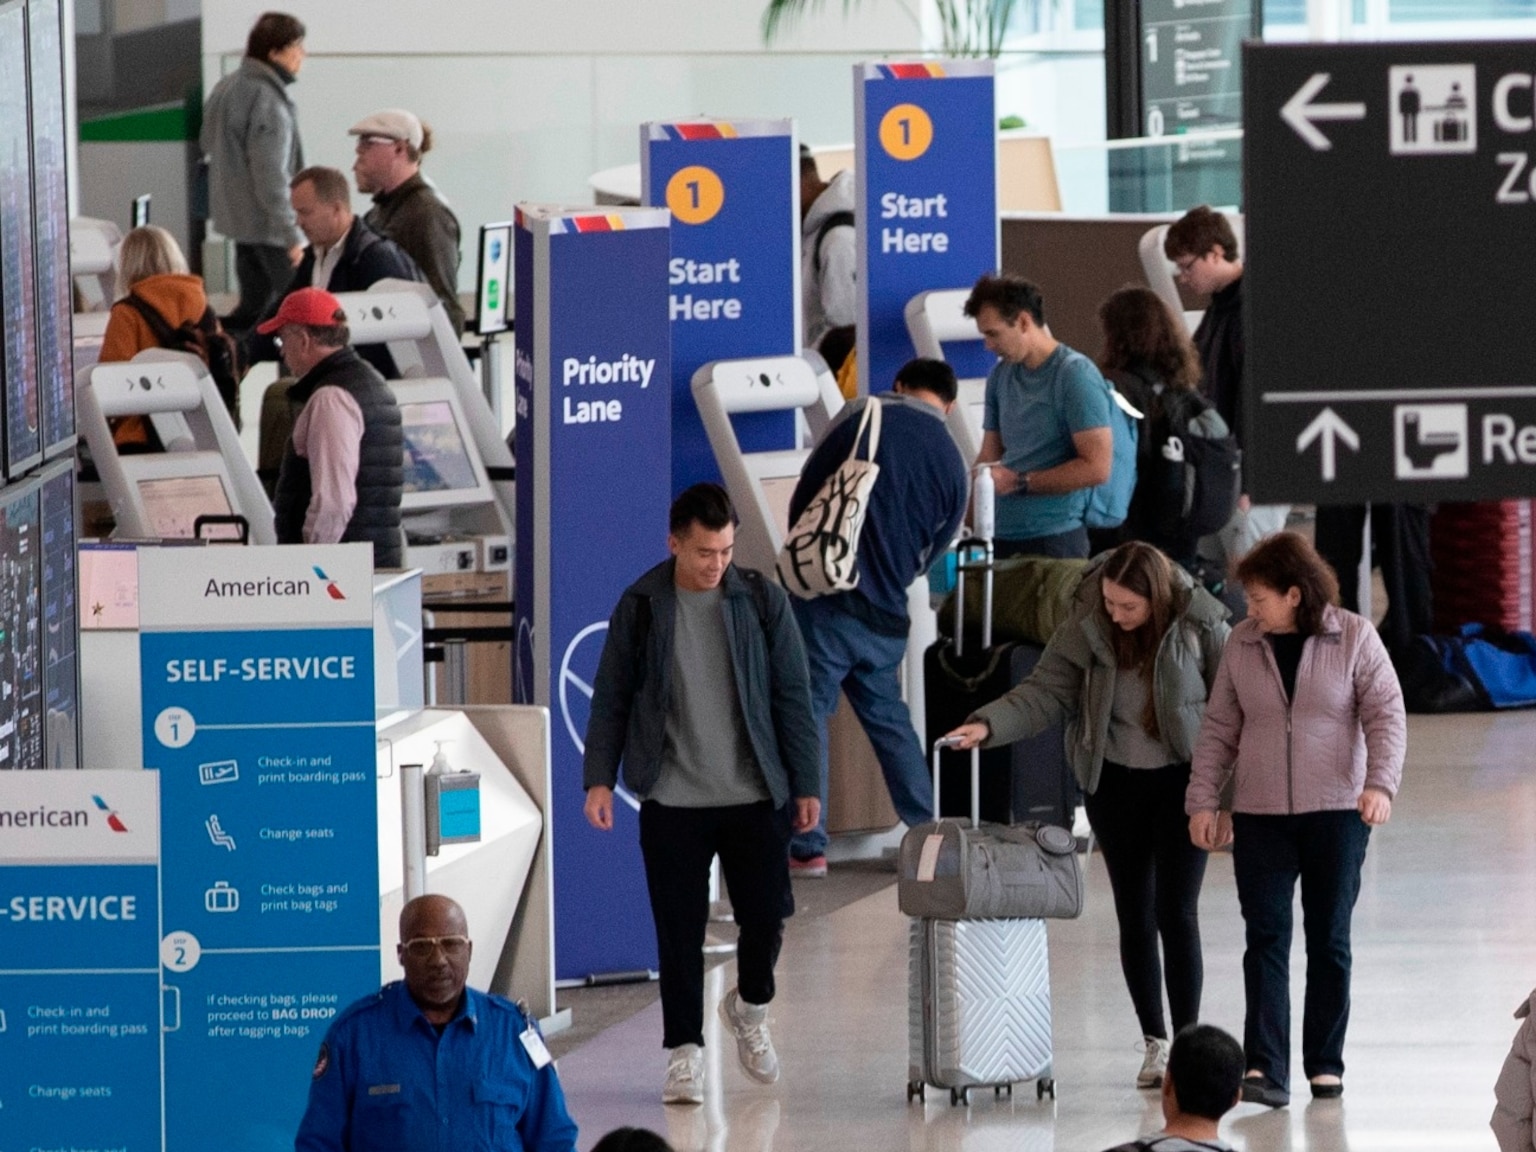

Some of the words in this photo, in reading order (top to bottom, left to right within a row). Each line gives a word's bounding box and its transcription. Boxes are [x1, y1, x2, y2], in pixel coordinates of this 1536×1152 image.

[898, 118, 910, 146] 1
[686, 180, 699, 209] 1
[881, 192, 948, 219] Start
[882, 227, 949, 253] Here
[668, 257, 741, 285] Start
[668, 294, 742, 321] Here
[563, 353, 655, 388] Priority
[563, 396, 622, 424] Lane
[204, 577, 310, 597] American
[166, 656, 355, 683] SELF-SERVICE
[170, 723, 179, 742] 1
[258, 755, 307, 768] Check-in
[310, 755, 332, 766] and
[258, 772, 285, 785] print
[289, 770, 339, 784] boarding
[342, 771, 366, 784] pass
[259, 827, 302, 841] Change
[305, 827, 334, 838] seats
[261, 883, 295, 896] Check
[298, 882, 324, 896] bags
[327, 882, 348, 894] and
[261, 899, 288, 912] print
[291, 899, 312, 912] bag
[315, 898, 338, 912] tags
[175, 946, 186, 966] 2
[218, 994, 268, 1008] checking
[302, 992, 338, 1005] please
[27, 1005, 82, 1018] Check-in
[86, 1005, 110, 1017] and
[208, 1008, 254, 1023] proceed
[257, 1010, 269, 1021] to
[272, 1008, 298, 1020] BAG
[301, 1007, 336, 1019] DROP
[28, 1023, 58, 1037] print
[61, 1022, 118, 1038] boarding
[121, 1024, 148, 1037] pass
[208, 1025, 235, 1037] after
[239, 1024, 281, 1038] tagging
[284, 1023, 310, 1036] bags
[29, 1084, 76, 1100] Change
[79, 1085, 112, 1097] seats
